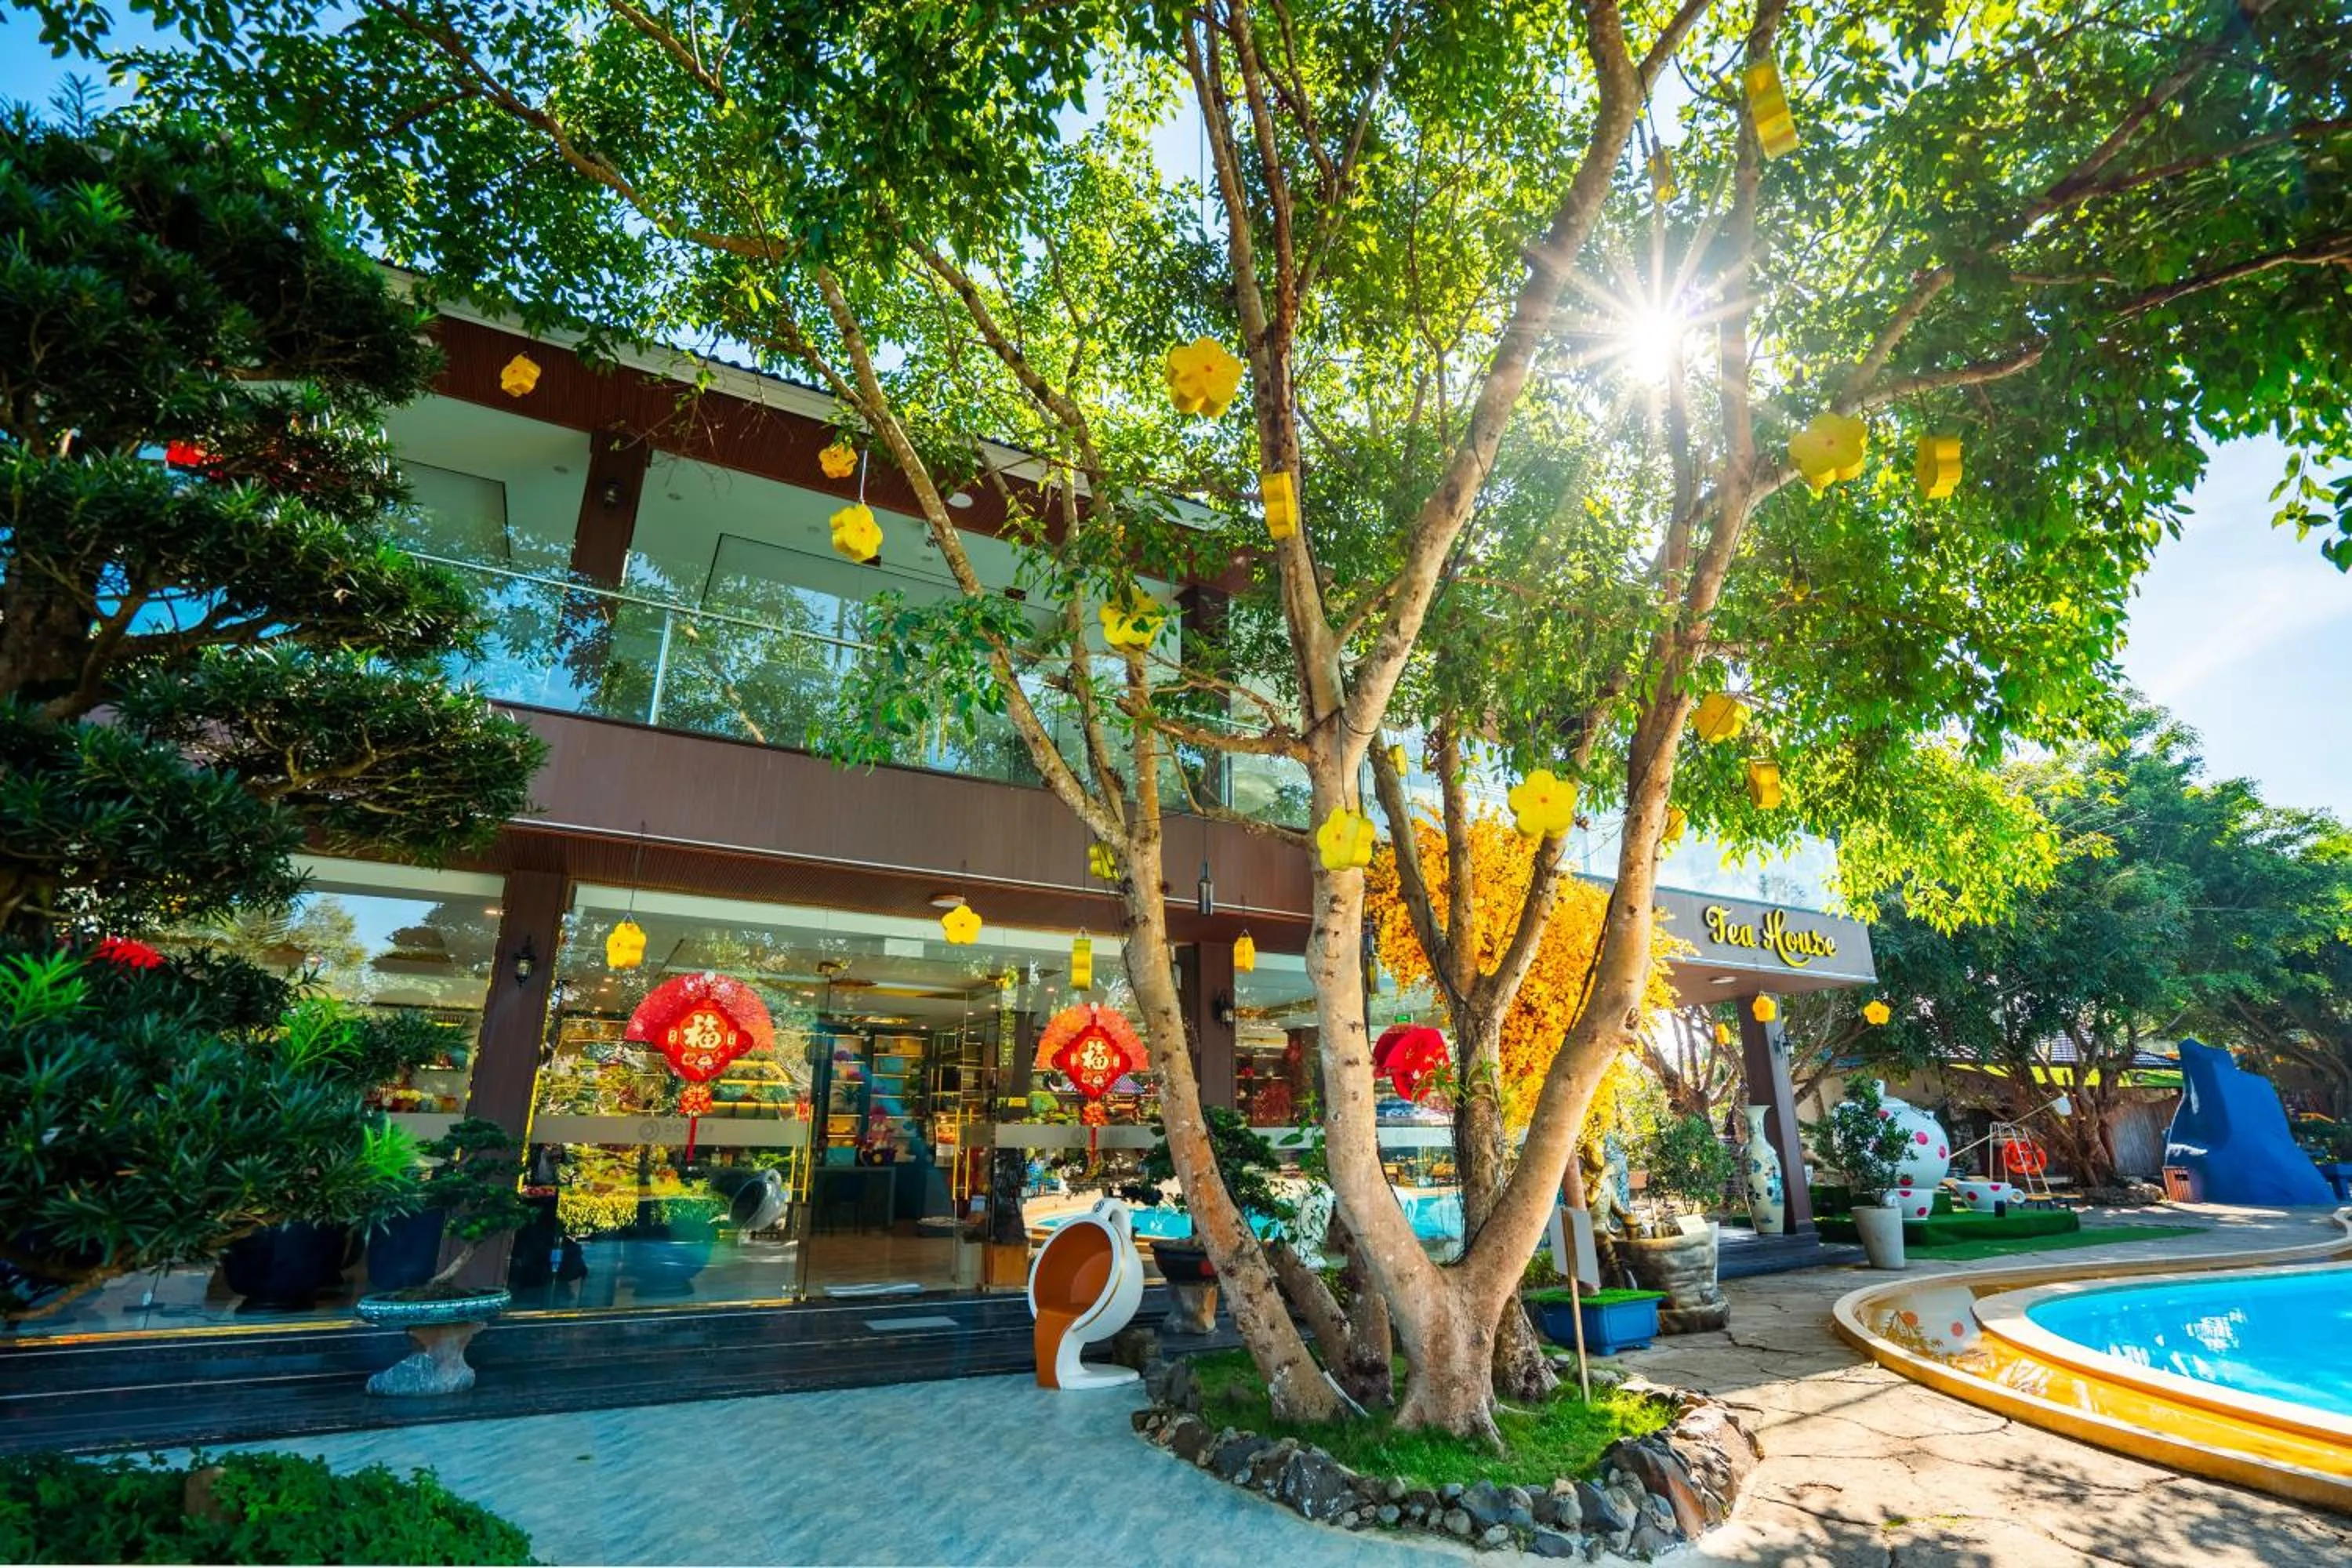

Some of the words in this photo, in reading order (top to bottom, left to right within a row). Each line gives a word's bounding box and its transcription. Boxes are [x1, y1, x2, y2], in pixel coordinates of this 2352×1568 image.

[1704, 904, 1758, 948] Tea
[1762, 908, 1838, 967] House
[683, 1013, 722, 1049] 福
[1081, 1040, 1109, 1070] 福
